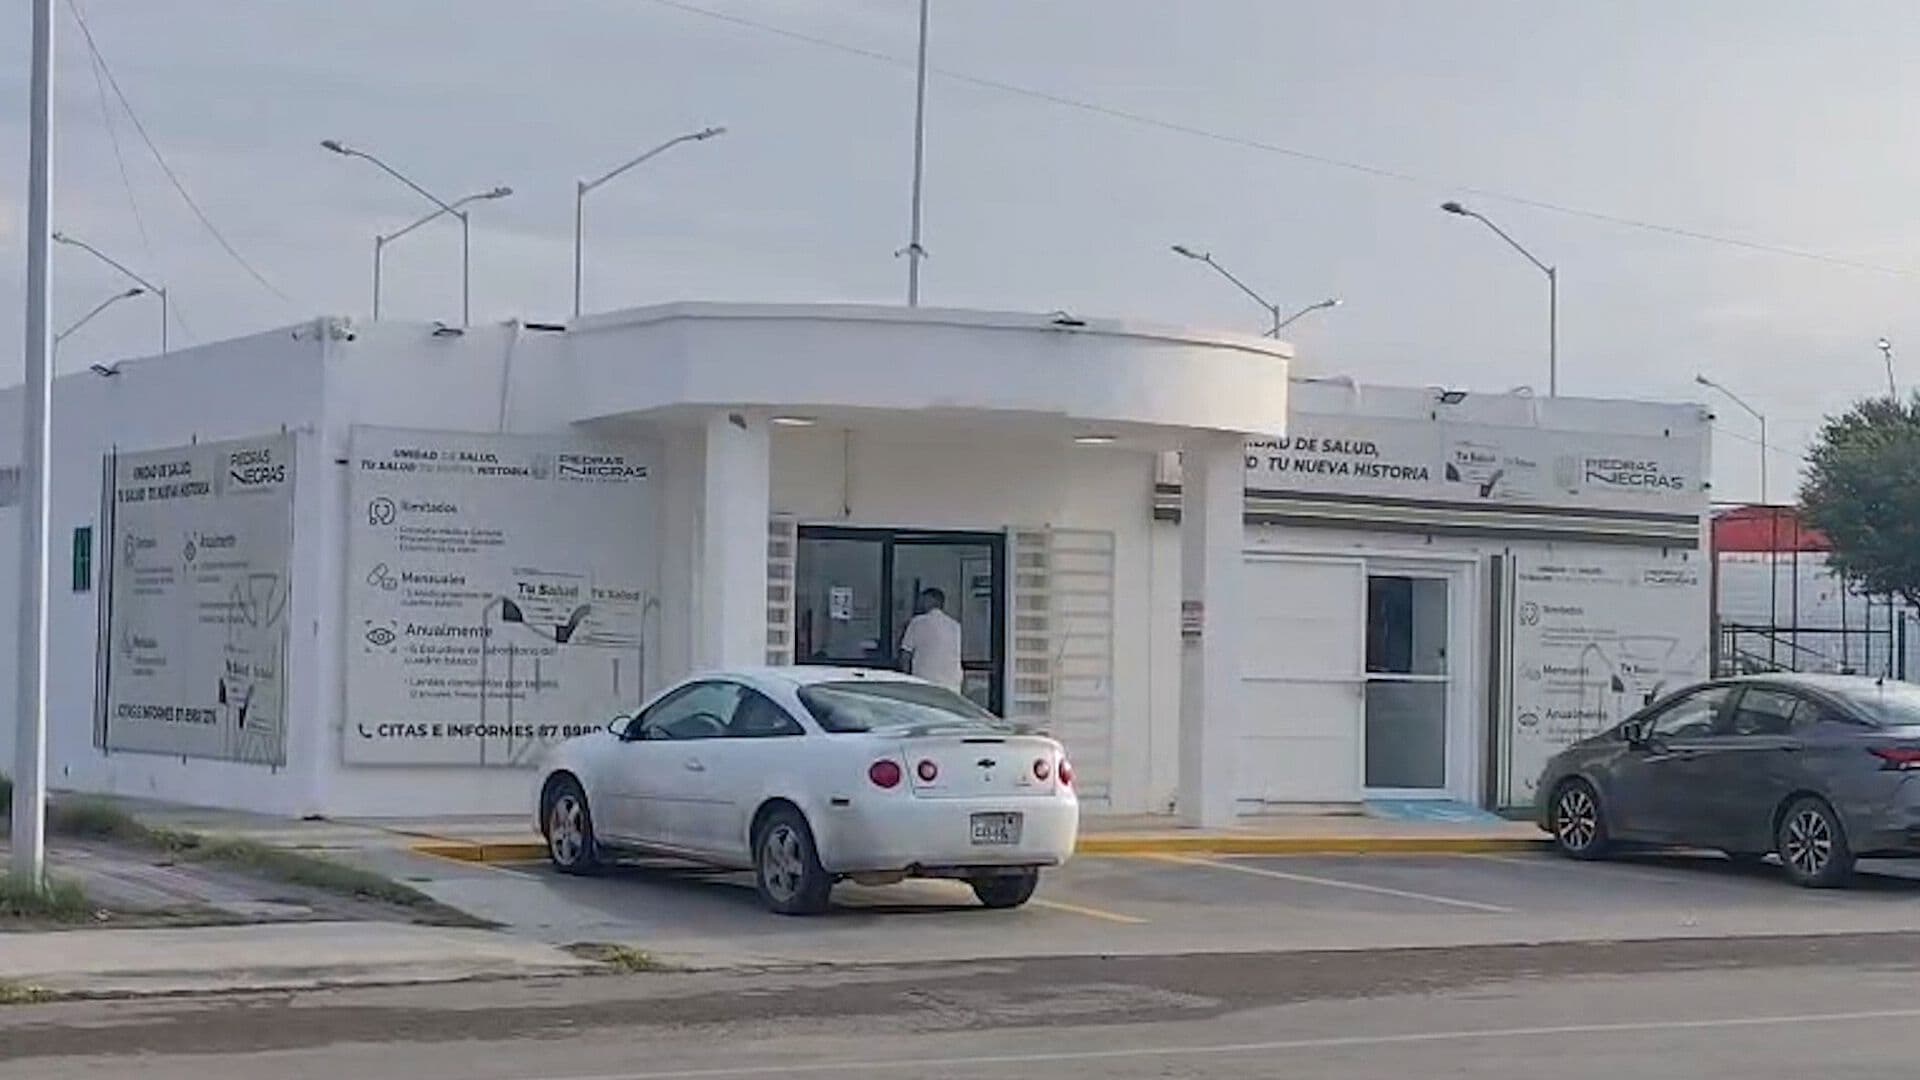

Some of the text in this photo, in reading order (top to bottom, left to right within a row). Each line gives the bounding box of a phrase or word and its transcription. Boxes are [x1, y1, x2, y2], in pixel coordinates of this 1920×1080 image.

[1296, 438, 1318, 451] DE
[1321, 440, 1379, 458] SALUD,
[231, 449, 272, 468] PIEDRAS
[560, 453, 624, 465] PIEDRAS
[1586, 458, 1658, 473] PIEDRAS
[230, 464, 286, 486] NEGRAS
[560, 464, 647, 478] NEGRAS
[1269, 456, 1290, 471] TU
[1294, 459, 1349, 476] NUEVA
[1353, 462, 1430, 481] HISTORIA
[1586, 471, 1684, 490] NEGRAS
[402, 572, 466, 585] Mensuales
[518, 582, 580, 598] Tu Salud
[406, 623, 494, 638] Anualmente
[378, 723, 427, 737] CITAS
[433, 724, 443, 737] E
[448, 724, 533, 737] INFORMES
